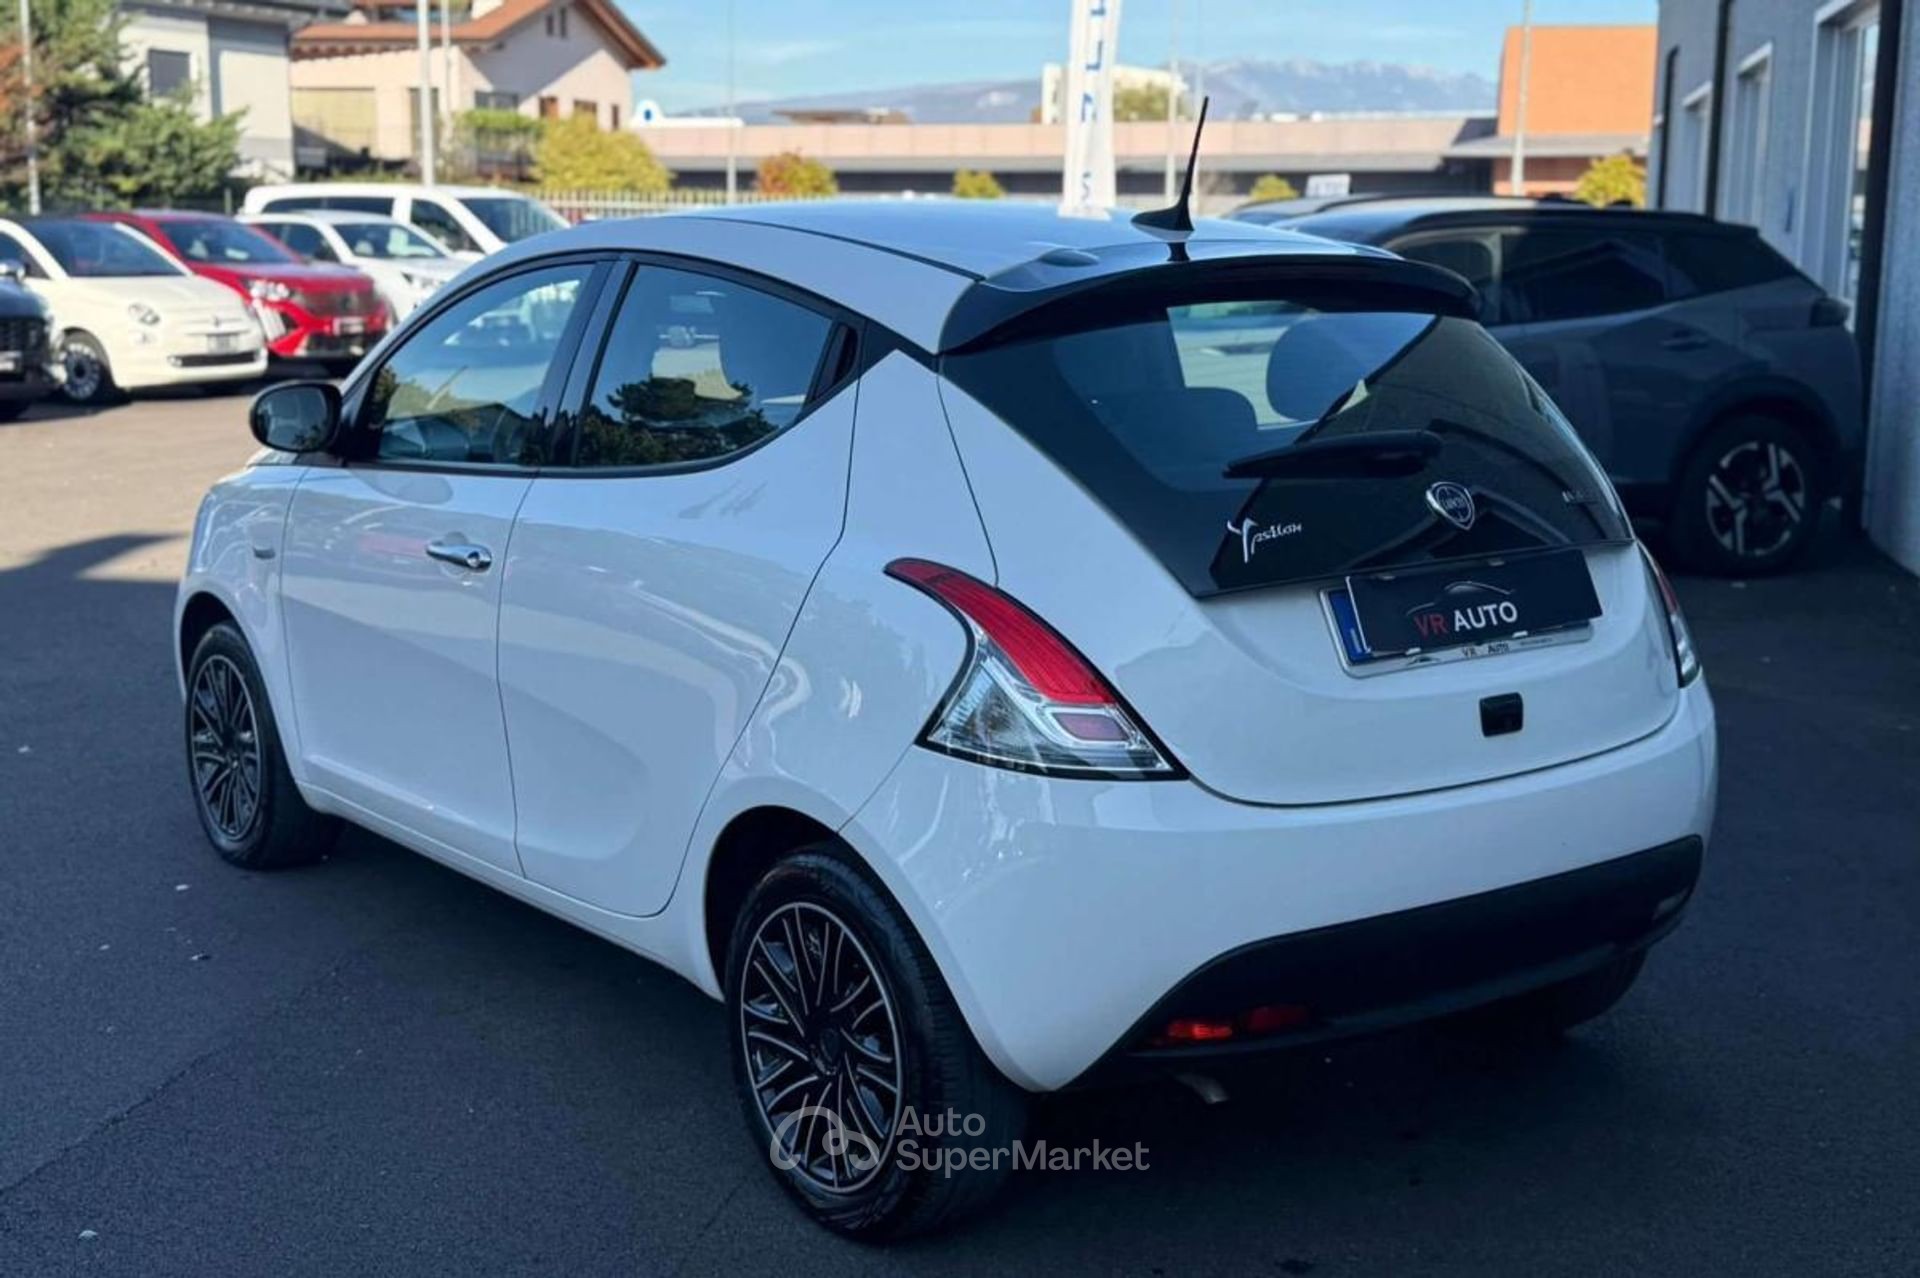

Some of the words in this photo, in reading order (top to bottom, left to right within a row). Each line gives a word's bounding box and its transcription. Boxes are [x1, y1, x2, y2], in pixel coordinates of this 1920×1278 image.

[1226, 517, 1302, 563] Ypsilon
[1413, 613, 1449, 638] VR
[1453, 601, 1519, 632] AUTO
